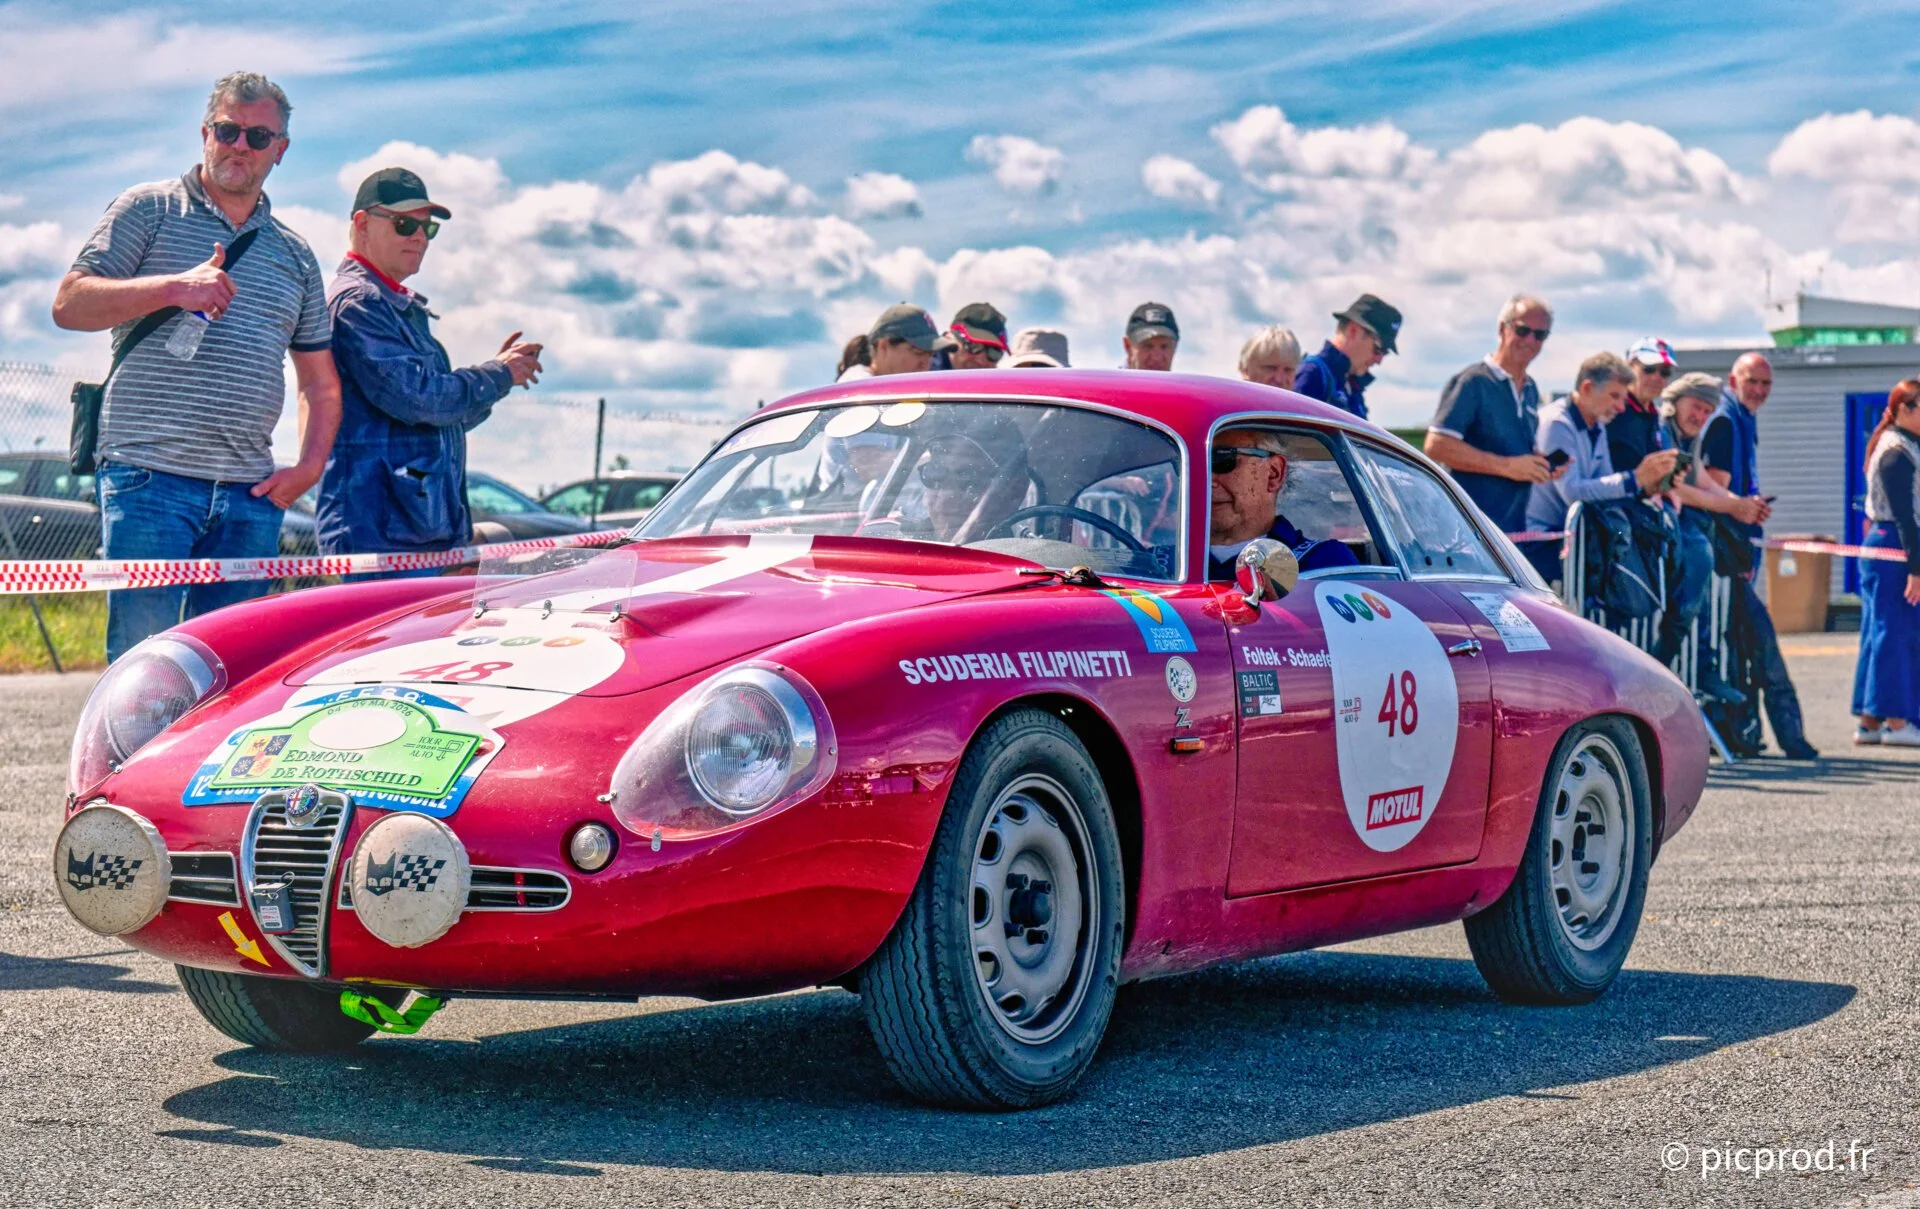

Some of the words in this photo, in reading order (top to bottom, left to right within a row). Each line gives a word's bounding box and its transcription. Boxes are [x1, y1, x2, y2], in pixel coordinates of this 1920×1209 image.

[1150, 627, 1182, 638] SCUDERIA
[1242, 646, 1281, 666] Foltek
[397, 661, 513, 682] 48
[899, 652, 1020, 685] SCUDERIA
[1020, 650, 1132, 678] FILIPINETTI
[1242, 673, 1274, 688] BALTIC
[327, 706, 342, 715] 04
[368, 699, 388, 708] MAI
[389, 702, 414, 717] 2026
[1378, 670, 1418, 738] 48
[418, 736, 443, 745] TOUR
[282, 749, 364, 763] EDMOND
[409, 750, 434, 758] AUTO
[271, 767, 298, 778] DE
[299, 765, 422, 787] ROTHSCHILD
[1368, 791, 1421, 825] MOTUL
